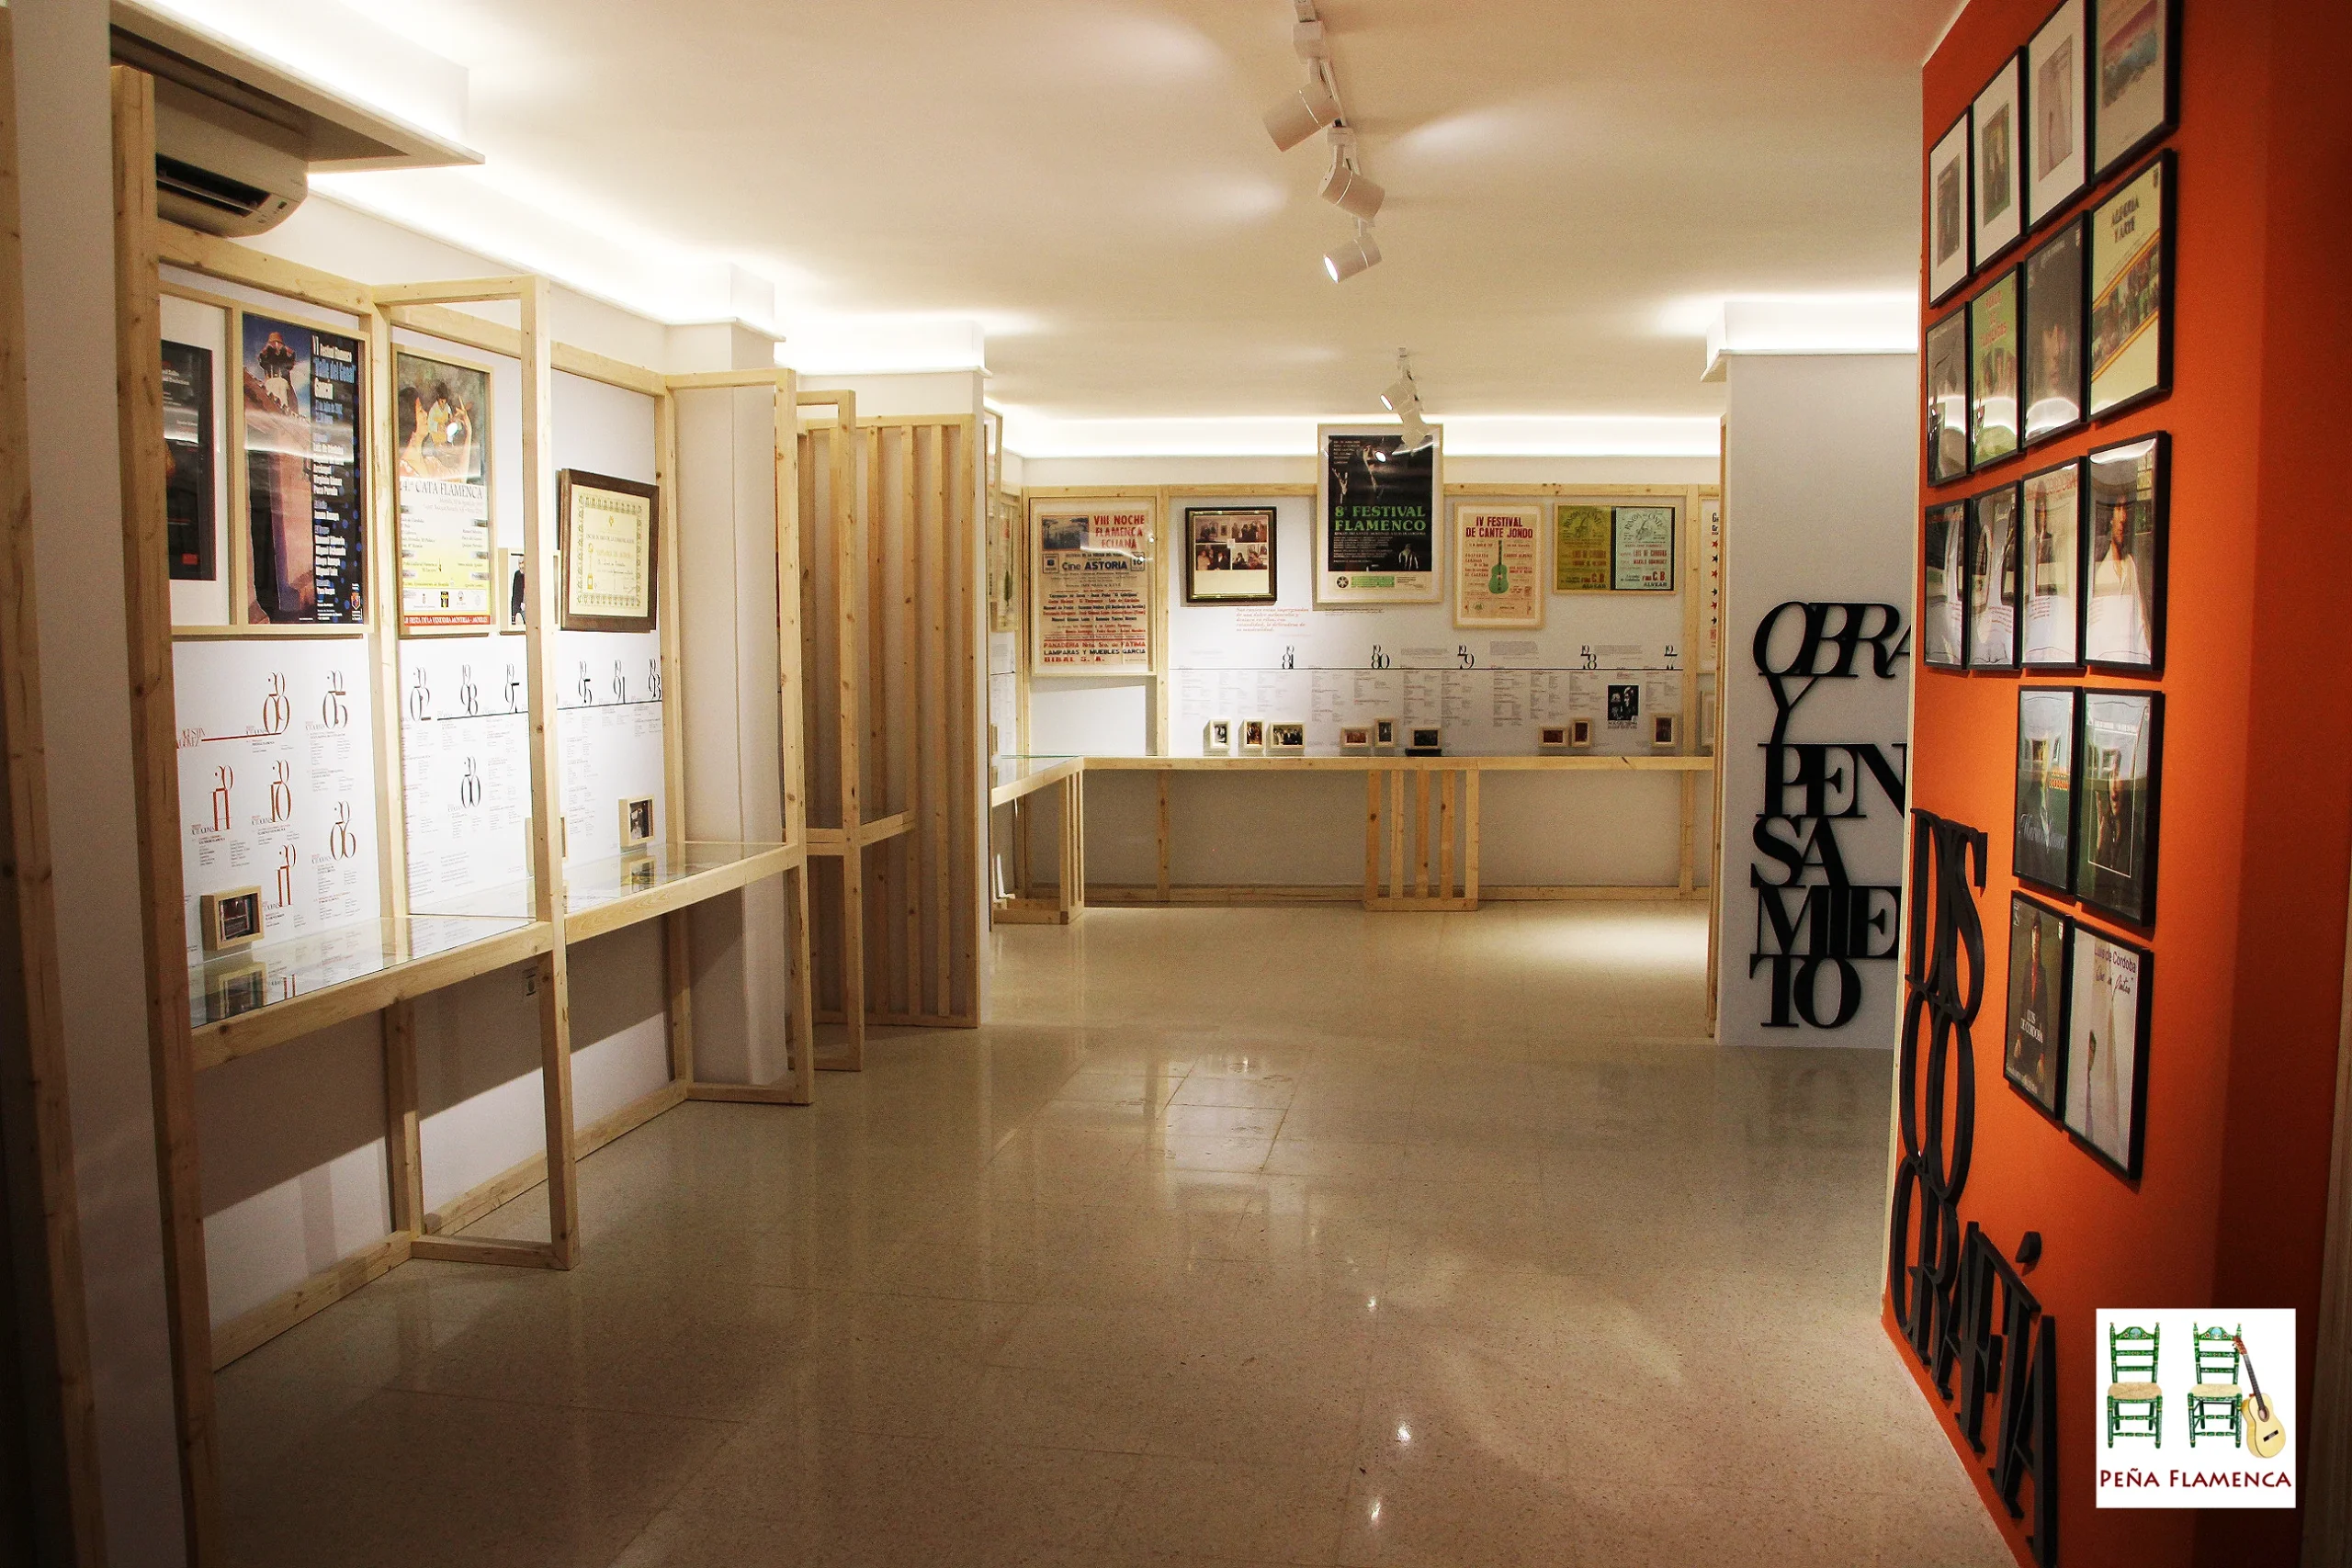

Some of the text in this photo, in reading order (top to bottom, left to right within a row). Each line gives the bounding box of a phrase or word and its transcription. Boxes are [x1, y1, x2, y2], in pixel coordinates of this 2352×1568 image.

[415, 480, 483, 500] CATA FLAMENCA
[1352, 505, 1426, 517] FESTIVAL
[1093, 514, 1145, 525] VIII NOCHE
[1334, 519, 1427, 531] FLAMENCO
[1476, 516, 1522, 527] IV FESTIVAL
[1095, 526, 1143, 537] FLAMENCA
[1465, 527, 1533, 538] DE CANTE JONDO
[1085, 560, 1128, 570] ASTORIA
[1765, 675, 1819, 745] Y
[1750, 815, 1849, 888] SA
[1749, 953, 1861, 1029] TO
